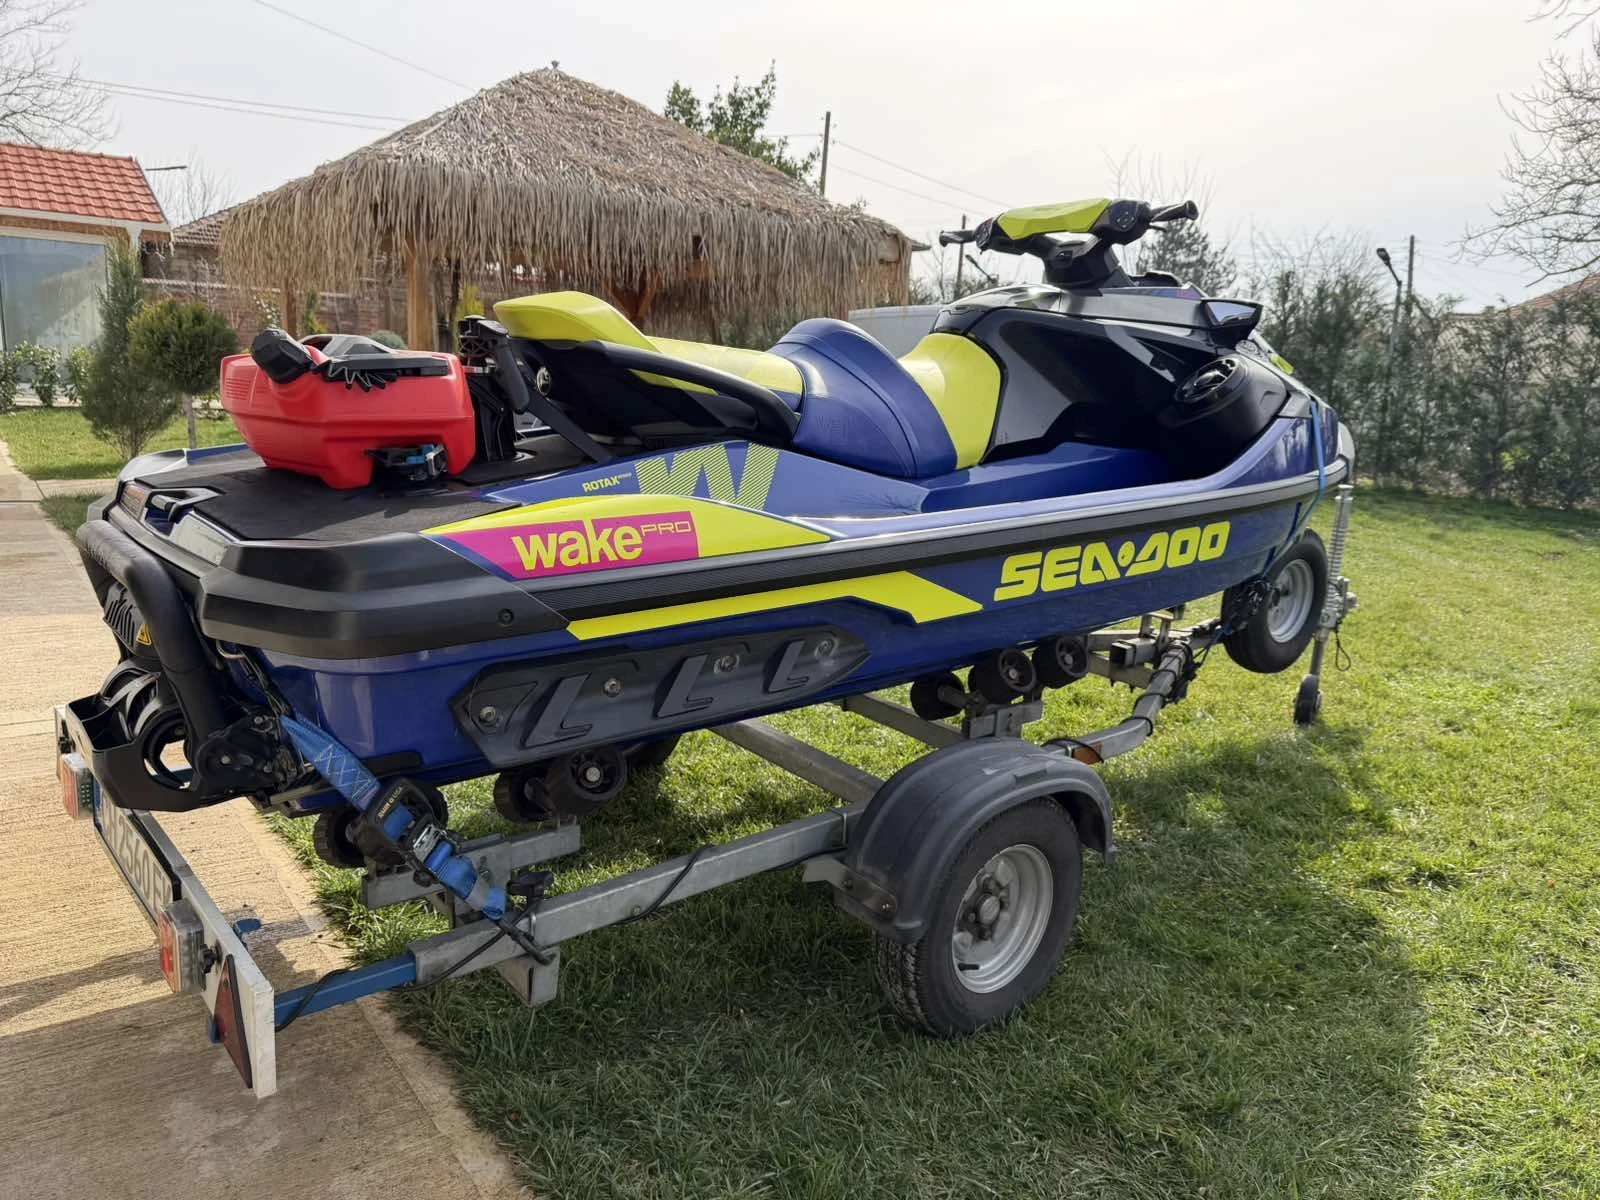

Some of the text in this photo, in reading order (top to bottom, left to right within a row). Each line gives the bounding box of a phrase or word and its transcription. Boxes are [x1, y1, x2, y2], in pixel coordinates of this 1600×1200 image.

[582, 475, 620, 493] ROTAX
[511, 519, 691, 572] wake PRO
